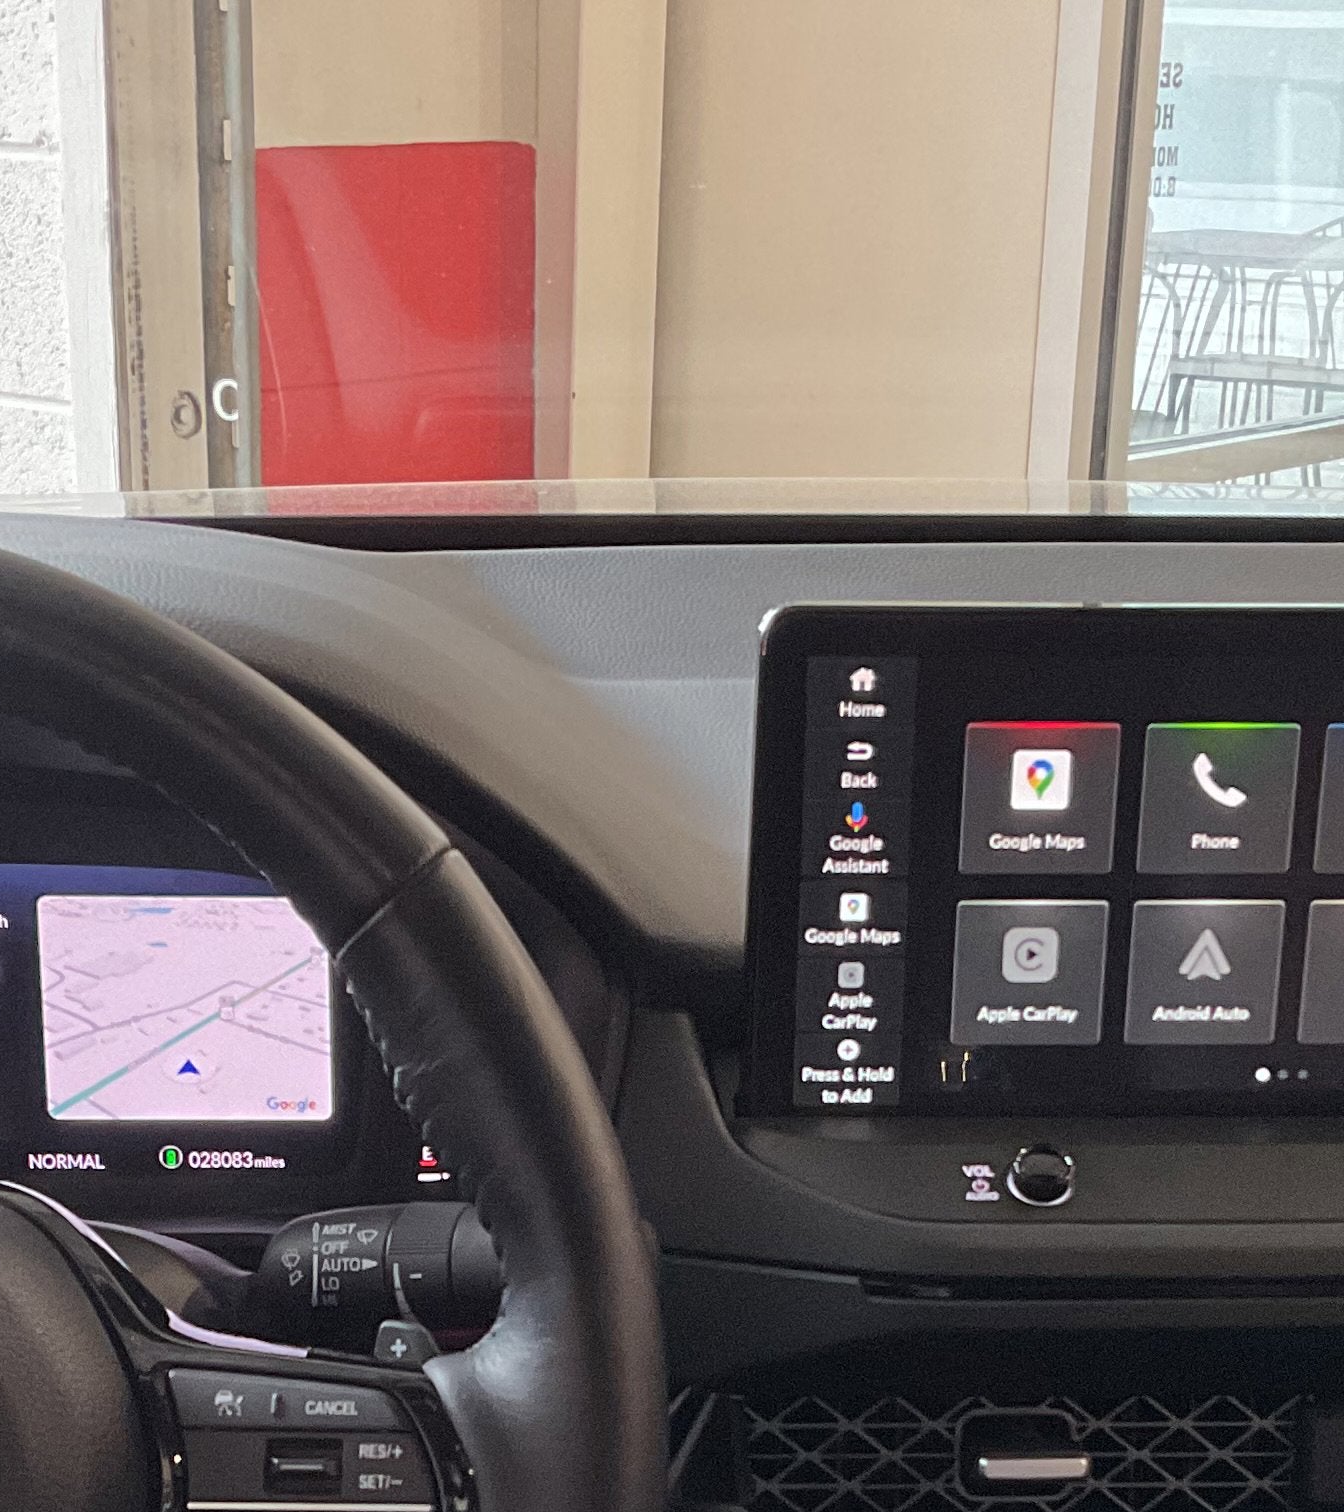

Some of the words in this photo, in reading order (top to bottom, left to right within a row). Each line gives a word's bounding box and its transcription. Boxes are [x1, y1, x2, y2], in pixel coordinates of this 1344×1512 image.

[839, 701, 886, 718] Home
[840, 771, 878, 788] Back
[829, 834, 883, 854] Google
[989, 834, 1040, 853] Google
[1045, 834, 1085, 853] Maps
[1191, 834, 1239, 850] Phone
[822, 855, 889, 874] Assistant
[805, 928, 858, 946] Google
[861, 928, 901, 946] Maps
[828, 992, 874, 1010] Apple
[821, 1013, 877, 1031] CarPlay
[976, 1005, 1020, 1023] Apple
[1024, 1005, 1077, 1023] CarPlay
[1152, 1005, 1210, 1023] Android
[1215, 1005, 1250, 1022] Auto
[801, 1066, 840, 1083] Press
[842, 1067, 855, 1082] &
[858, 1065, 895, 1083] Hold
[266, 1096, 317, 1113] Google
[822, 1088, 838, 1104] to
[840, 1088, 873, 1104] Add
[27, 1153, 106, 1170] NORMAL
[187, 1151, 254, 1169] 028083
[254, 1155, 286, 1169] miles
[322, 1222, 356, 1236] MIST
[321, 1241, 349, 1256] OFF
[321, 1257, 360, 1273] AUTO
[305, 1400, 358, 1417] CANCEL
